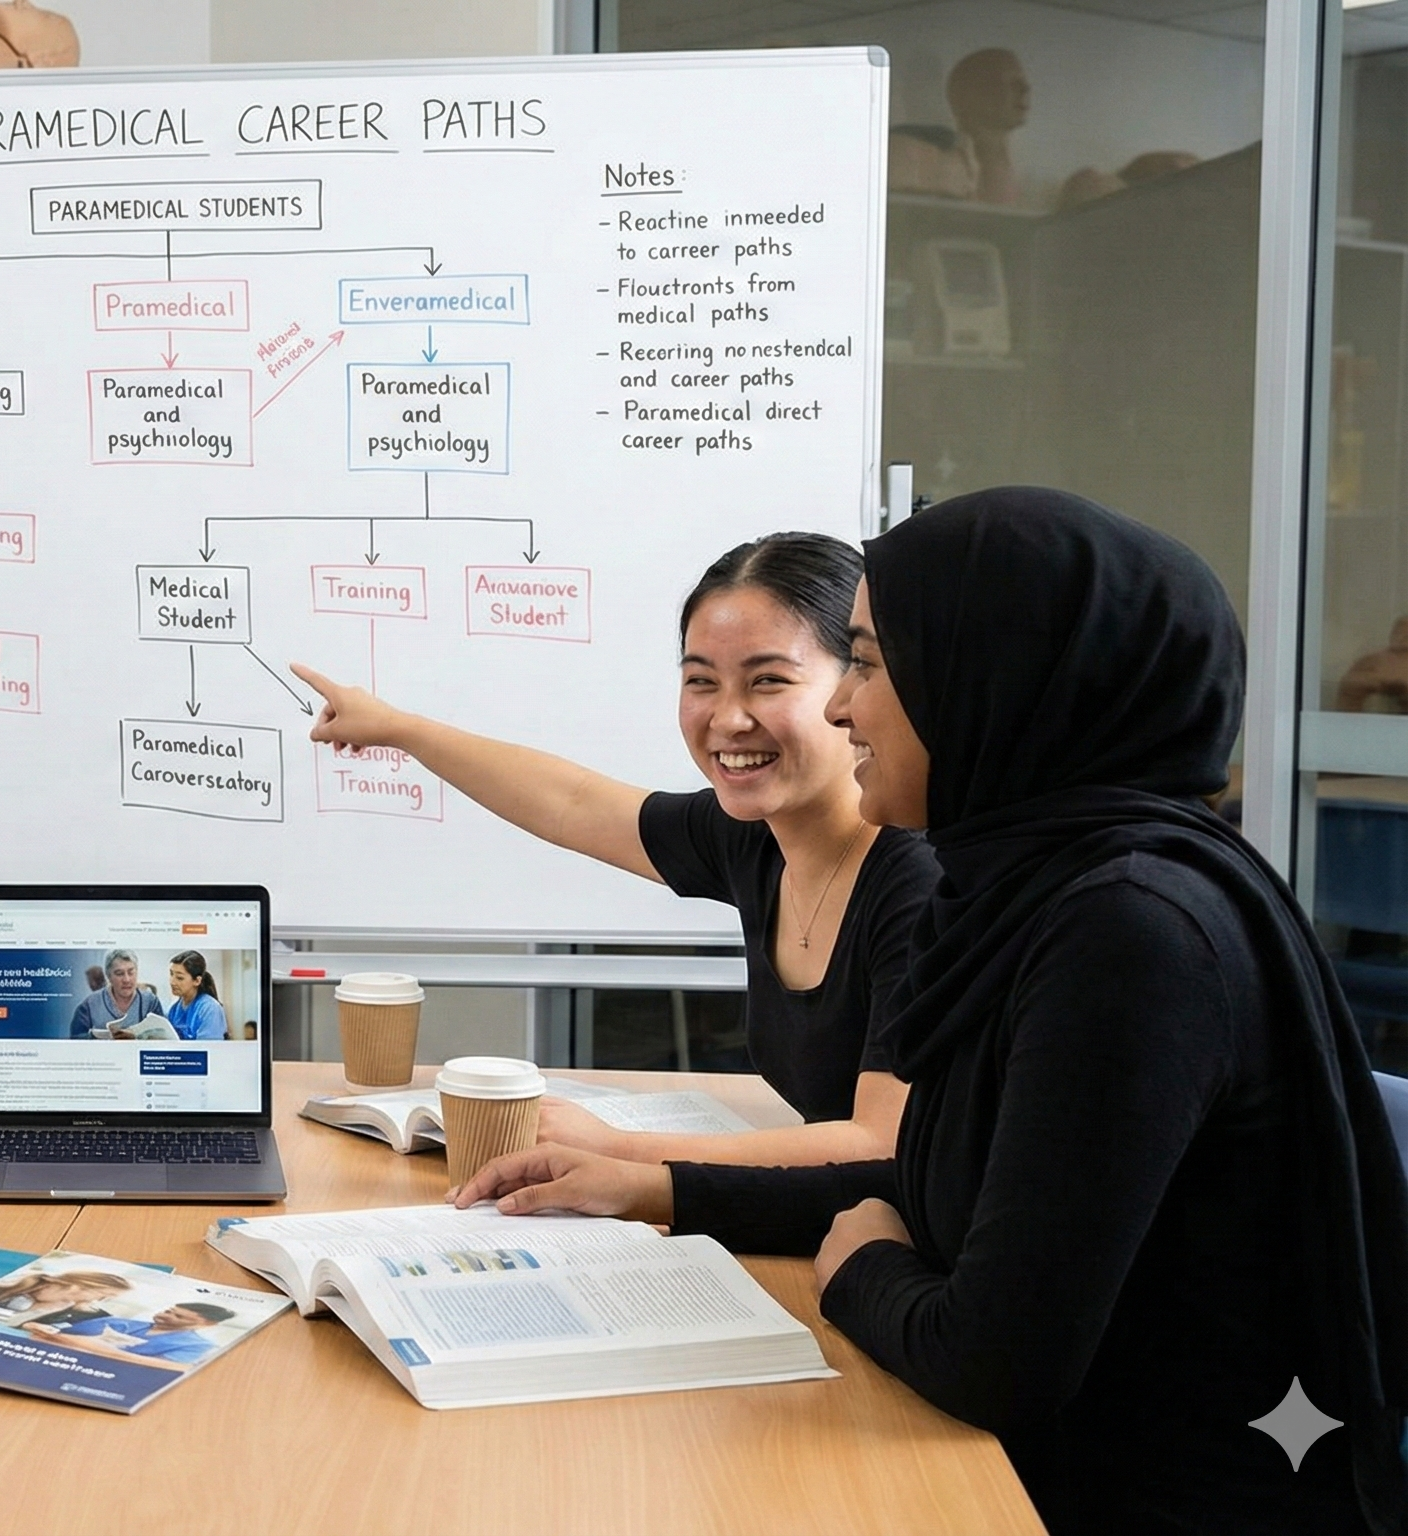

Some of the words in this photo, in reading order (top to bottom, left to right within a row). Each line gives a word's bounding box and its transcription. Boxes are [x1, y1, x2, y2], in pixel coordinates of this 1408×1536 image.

[237, 101, 389, 145] CAREER
[422, 98, 546, 140] PATHS
[49, 199, 189, 222] PARAMEDICAL
[199, 196, 303, 218] STUDENTS
[616, 242, 637, 261] to
[647, 244, 720, 260] carreer
[734, 236, 793, 267] paths
[747, 271, 796, 294] from
[106, 290, 234, 318] Pramedical
[349, 285, 515, 312] Enveramedical
[617, 302, 695, 325] medical
[711, 301, 769, 329] paths
[103, 377, 223, 399] Paramedical
[361, 371, 490, 396] Paramedical
[619, 368, 657, 388] and
[670, 373, 730, 388] career
[740, 366, 794, 394] paths
[143, 405, 181, 424] and
[401, 403, 442, 424] and
[624, 399, 751, 422] Paramedical
[765, 399, 823, 421] direct
[368, 429, 490, 464] psychiology
[621, 434, 684, 450] career
[695, 428, 753, 457] paths
[149, 575, 229, 600] Medical
[322, 576, 411, 612] Training
[157, 605, 237, 630] Student
[132, 728, 244, 760] Paramedical
[333, 769, 423, 811] Training
